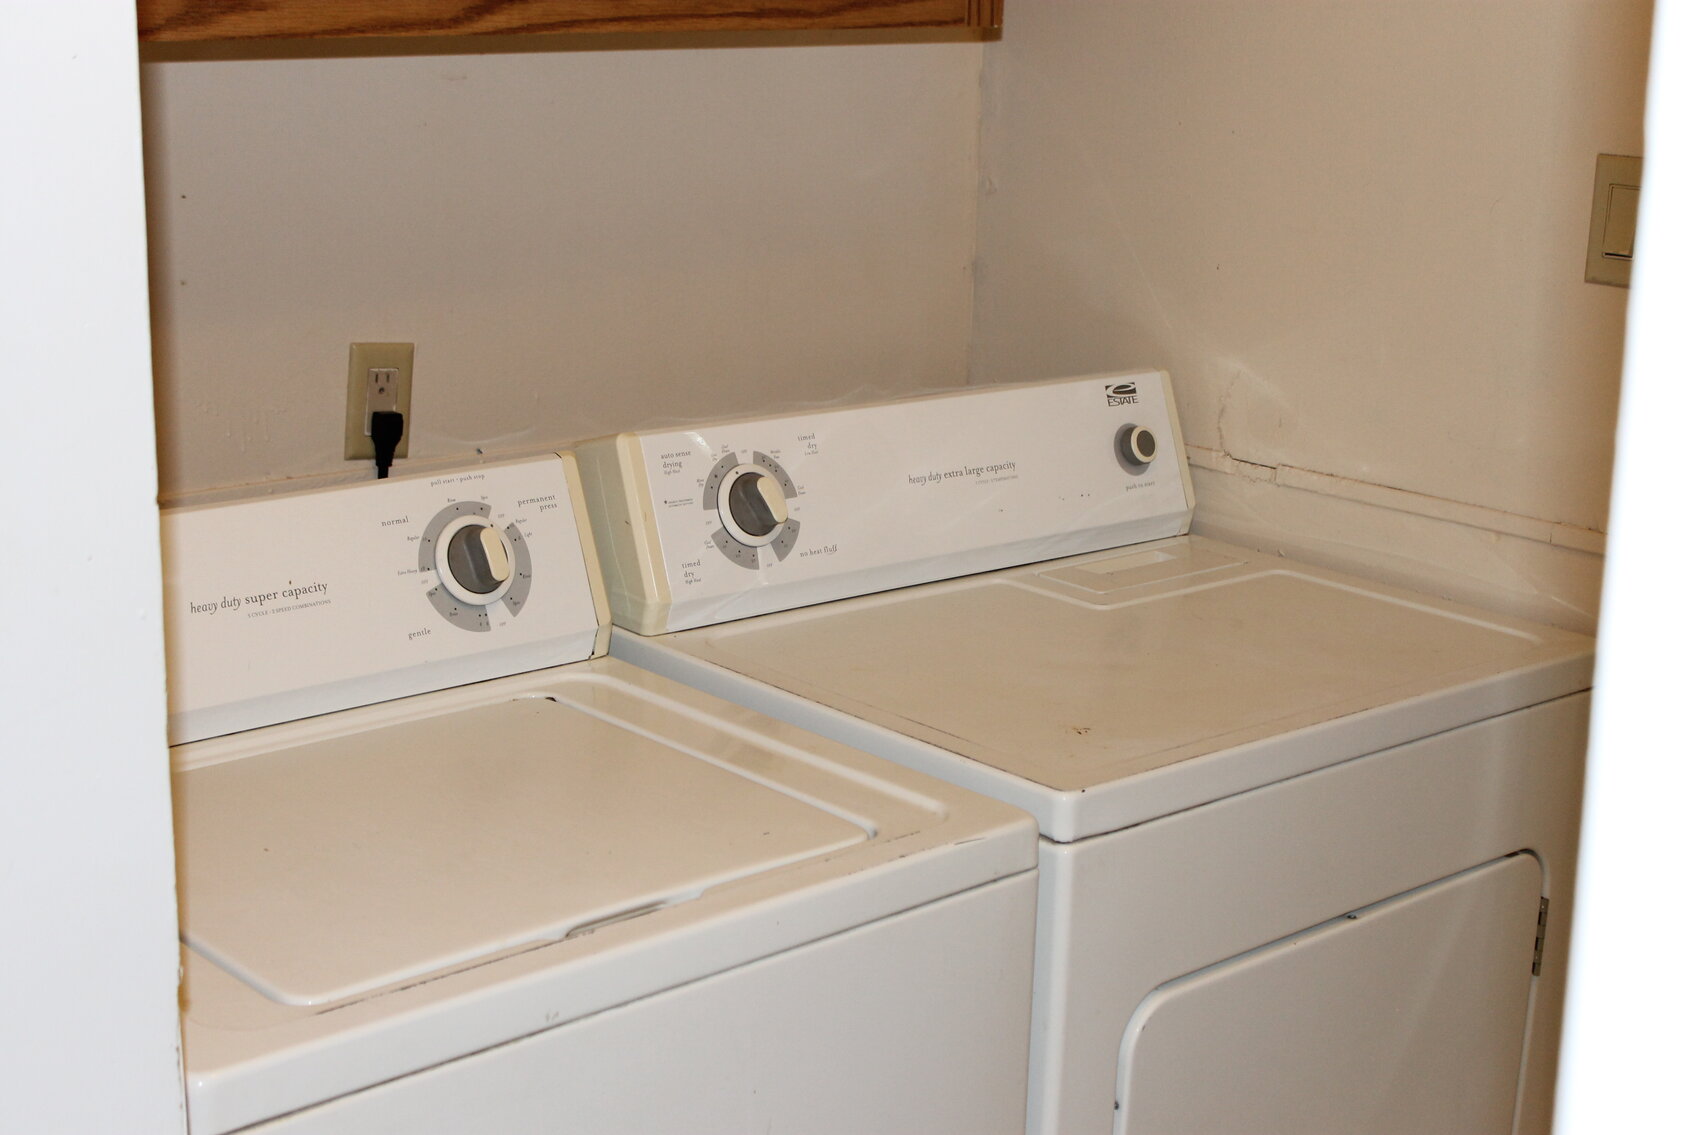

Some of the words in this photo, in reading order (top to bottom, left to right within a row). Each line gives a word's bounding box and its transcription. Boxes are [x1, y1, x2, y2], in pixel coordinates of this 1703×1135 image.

[1107, 395, 1139, 407] ESTATE
[797, 433, 816, 441] timed
[807, 442, 817, 450] dry
[662, 461, 682, 469] drying
[908, 474, 927, 486] heavy
[928, 471, 942, 484] duty
[943, 470, 964, 479] extra
[964, 466, 985, 477] large
[986, 461, 1016, 474] capacity
[430, 479, 442, 487] pull
[460, 475, 472, 483] push
[1125, 483, 1137, 492] push
[517, 494, 556, 508] permanent
[539, 503, 558, 512] press
[381, 515, 409, 527] normal
[823, 544, 838, 553] fluff
[681, 558, 701, 569] timed
[683, 571, 695, 579] dry
[189, 602, 218, 615] heavy
[220, 596, 242, 611] duty
[244, 591, 279, 606] super
[281, 582, 329, 600] capacity
[251, 610, 269, 618] CYCLE
[276, 606, 292, 614] SPEED
[291, 599, 332, 611] COMBINATIONS
[408, 628, 432, 640] gentle
